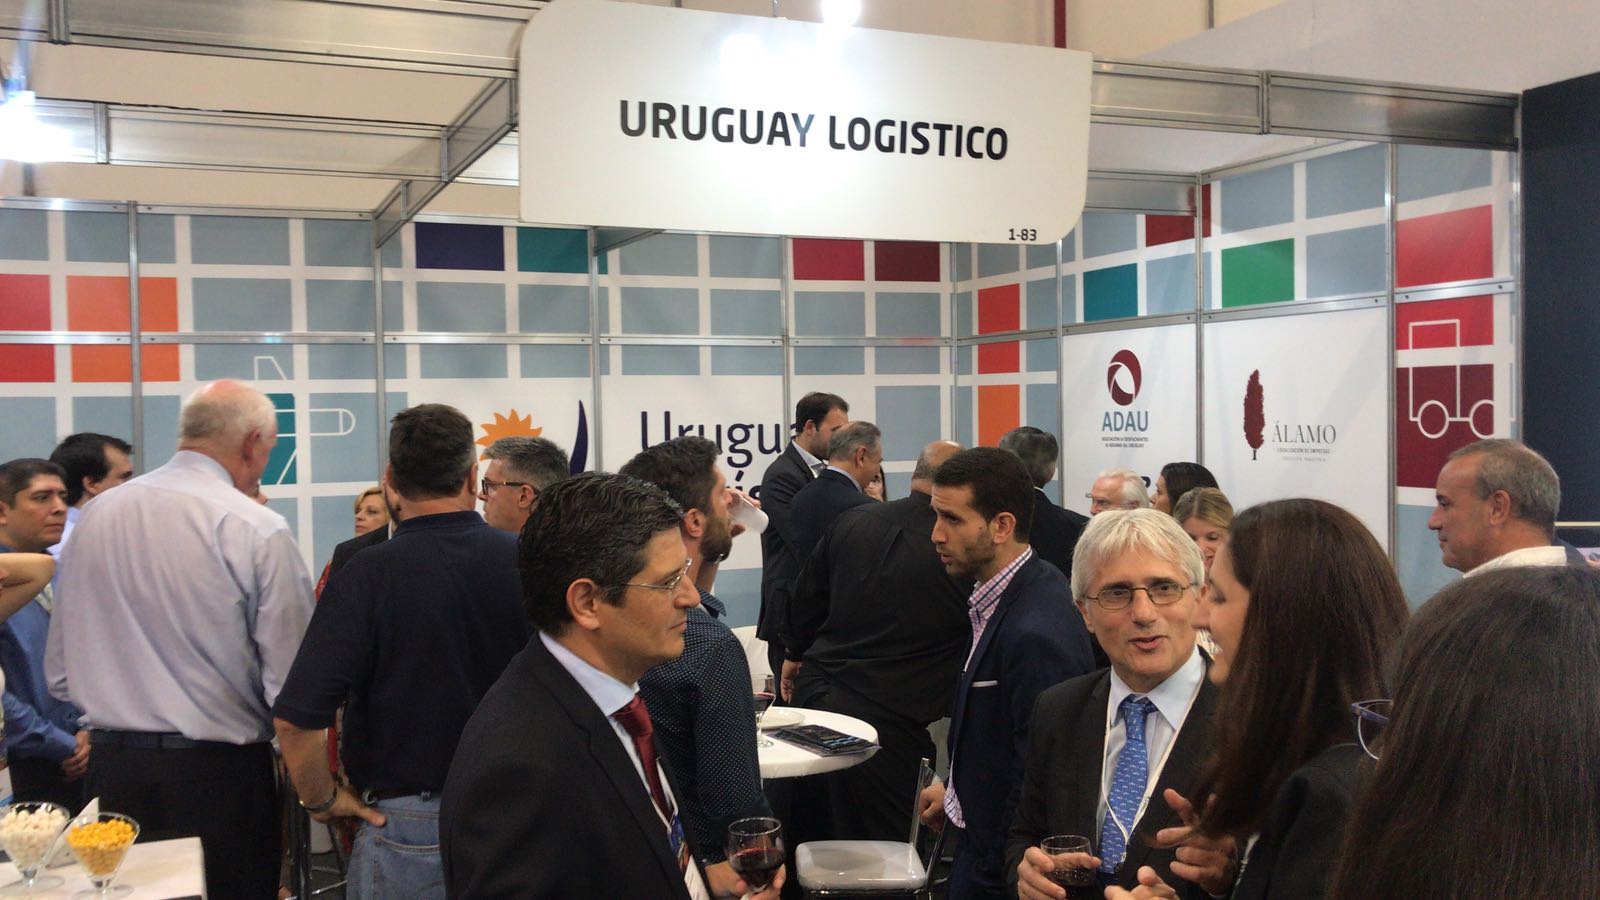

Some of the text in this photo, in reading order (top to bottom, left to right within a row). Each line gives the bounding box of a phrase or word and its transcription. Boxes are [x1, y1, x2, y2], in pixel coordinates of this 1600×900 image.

[620, 100, 1009, 161] URUGUAY LOGISTICO
[1008, 228, 1037, 241] 1-83
[1102, 410, 1149, 432] ADAU
[1271, 420, 1337, 445] ÁLAMO
